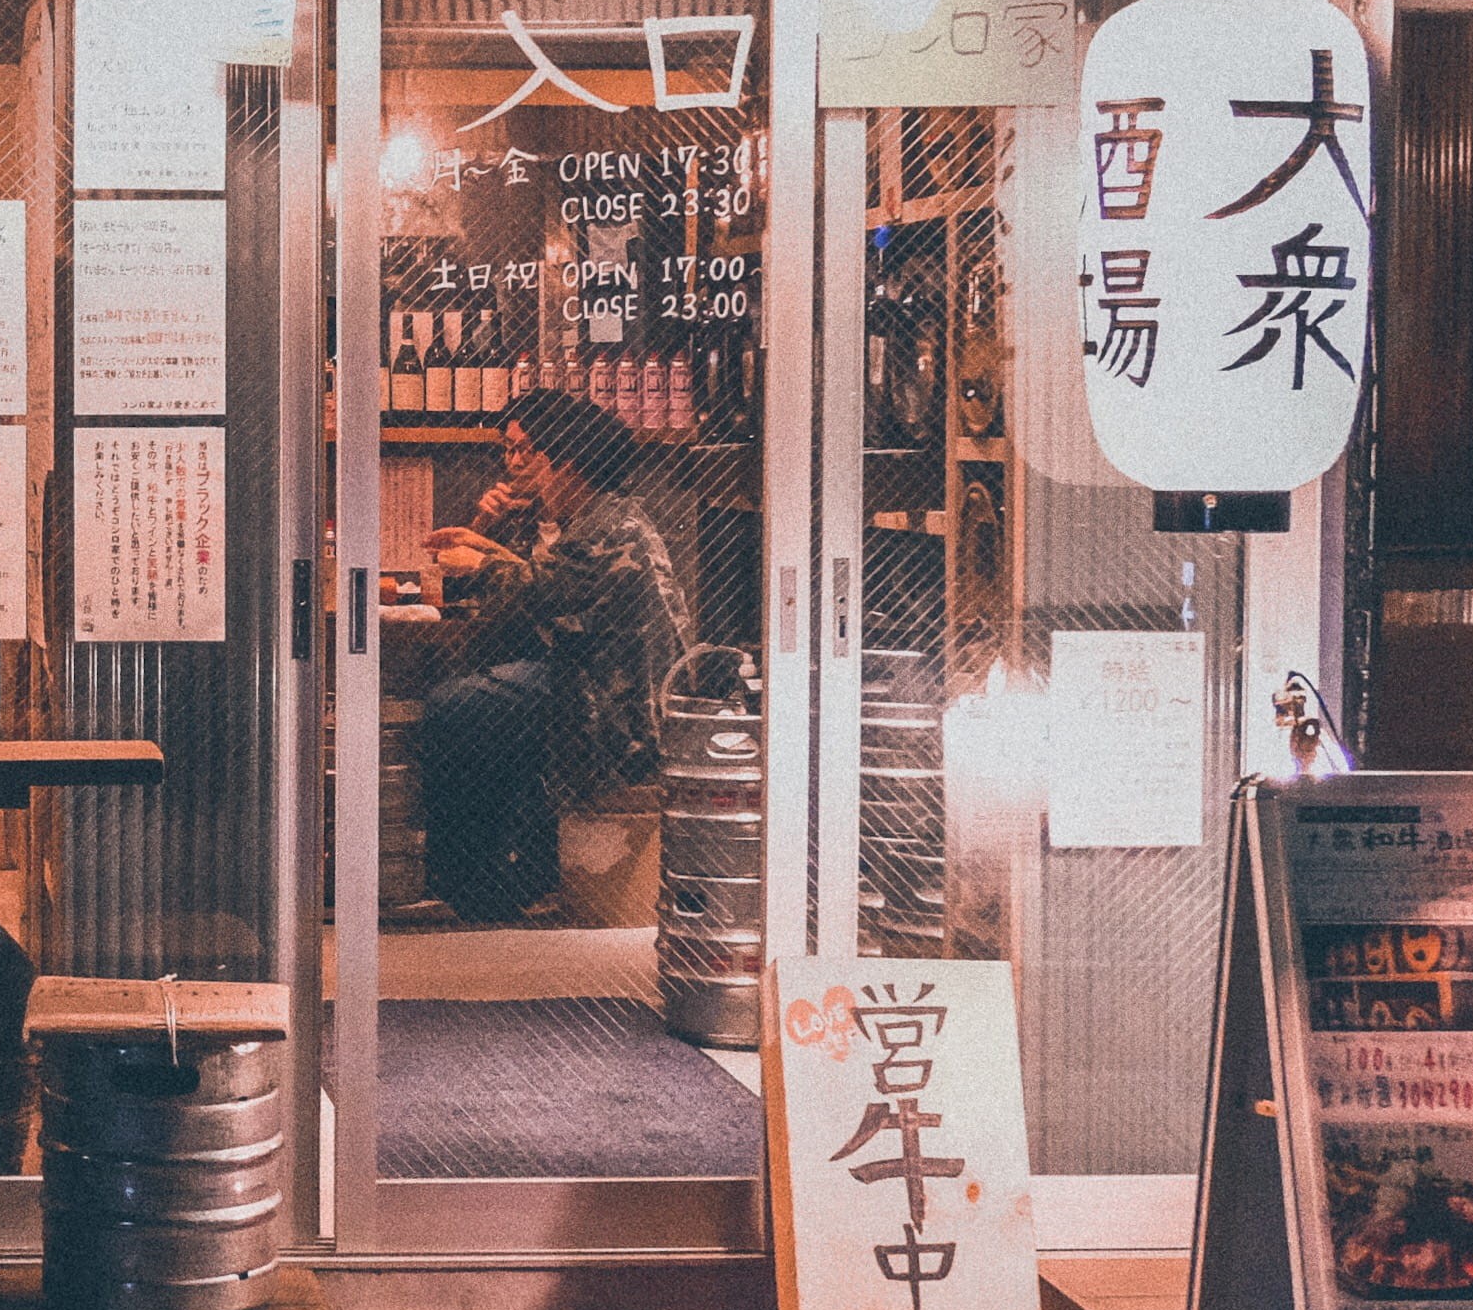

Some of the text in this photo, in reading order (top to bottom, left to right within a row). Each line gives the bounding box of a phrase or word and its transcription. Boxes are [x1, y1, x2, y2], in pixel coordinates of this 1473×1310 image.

[456, 9, 754, 132] 入口
[559, 150, 641, 182] OPEN
[660, 145, 751, 178] 17:30
[561, 188, 751, 223] CLOSE 23:30
[1204, 49, 1371, 390] 大衆
[562, 260, 639, 290] OPEN
[661, 256, 746, 283] 17:00
[563, 292, 747, 321] CLOSE 23:00
